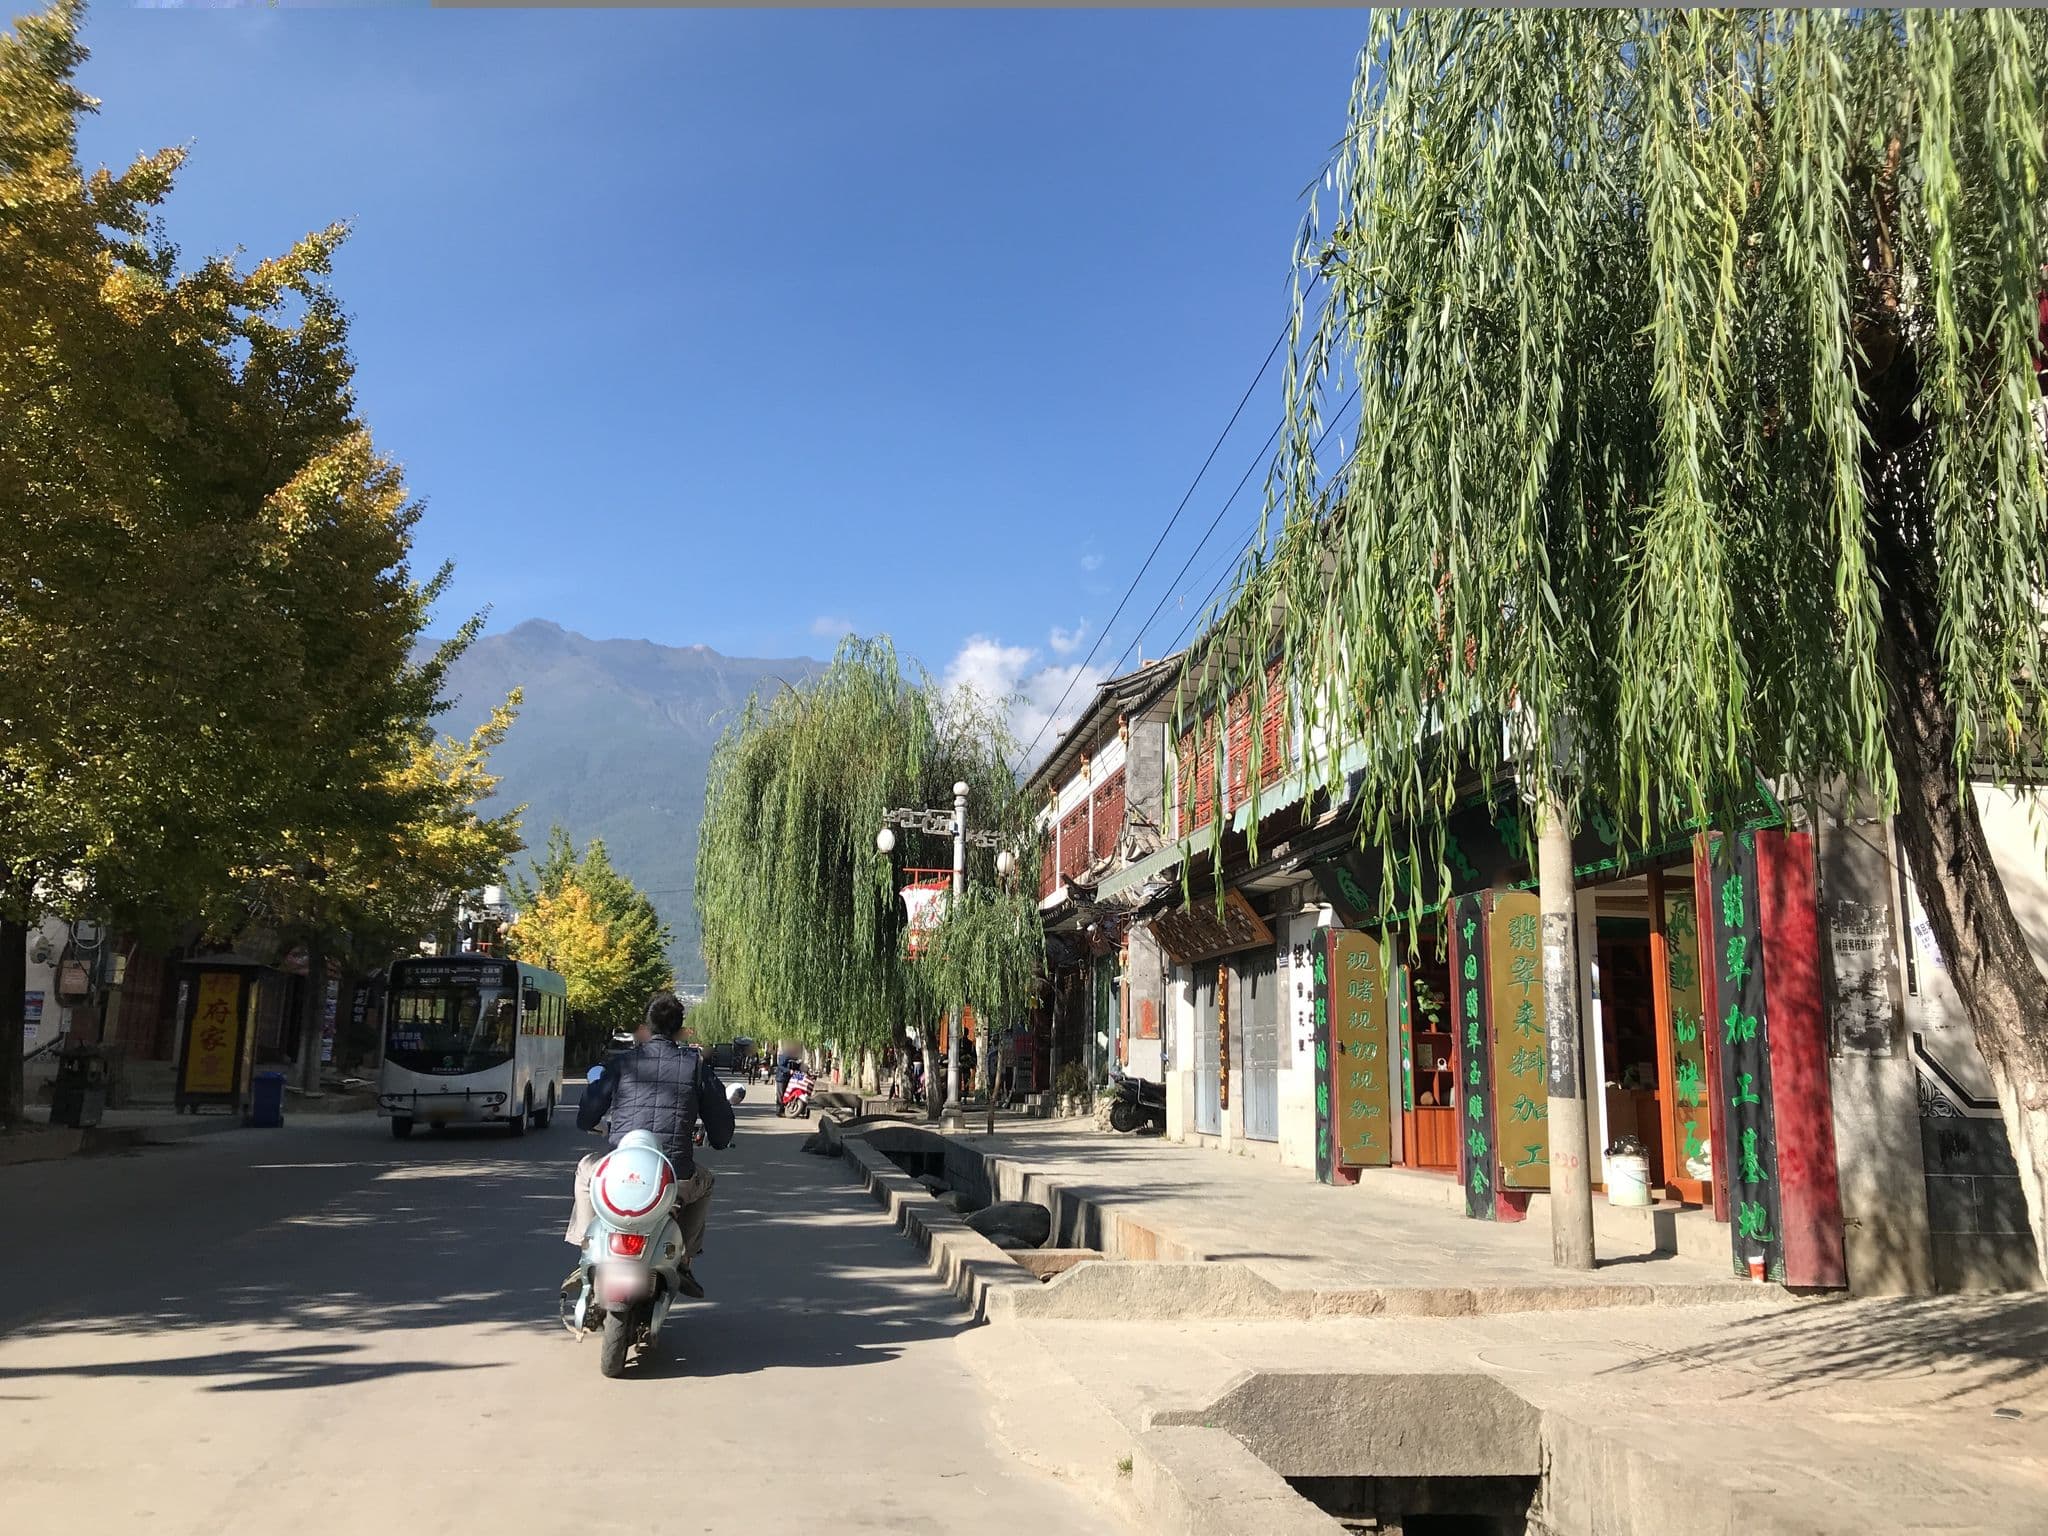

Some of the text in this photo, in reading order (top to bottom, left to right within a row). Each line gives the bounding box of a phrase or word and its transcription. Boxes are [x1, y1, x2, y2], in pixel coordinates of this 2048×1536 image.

[1346, 952, 1380, 1149] 现赌现切现加工
[1463, 918, 1488, 1194] 中国翡翠玉雕协会
[1507, 913, 1549, 1168] 翡翠来料加工
[1722, 874, 1774, 1243] 翡翠加工基地
